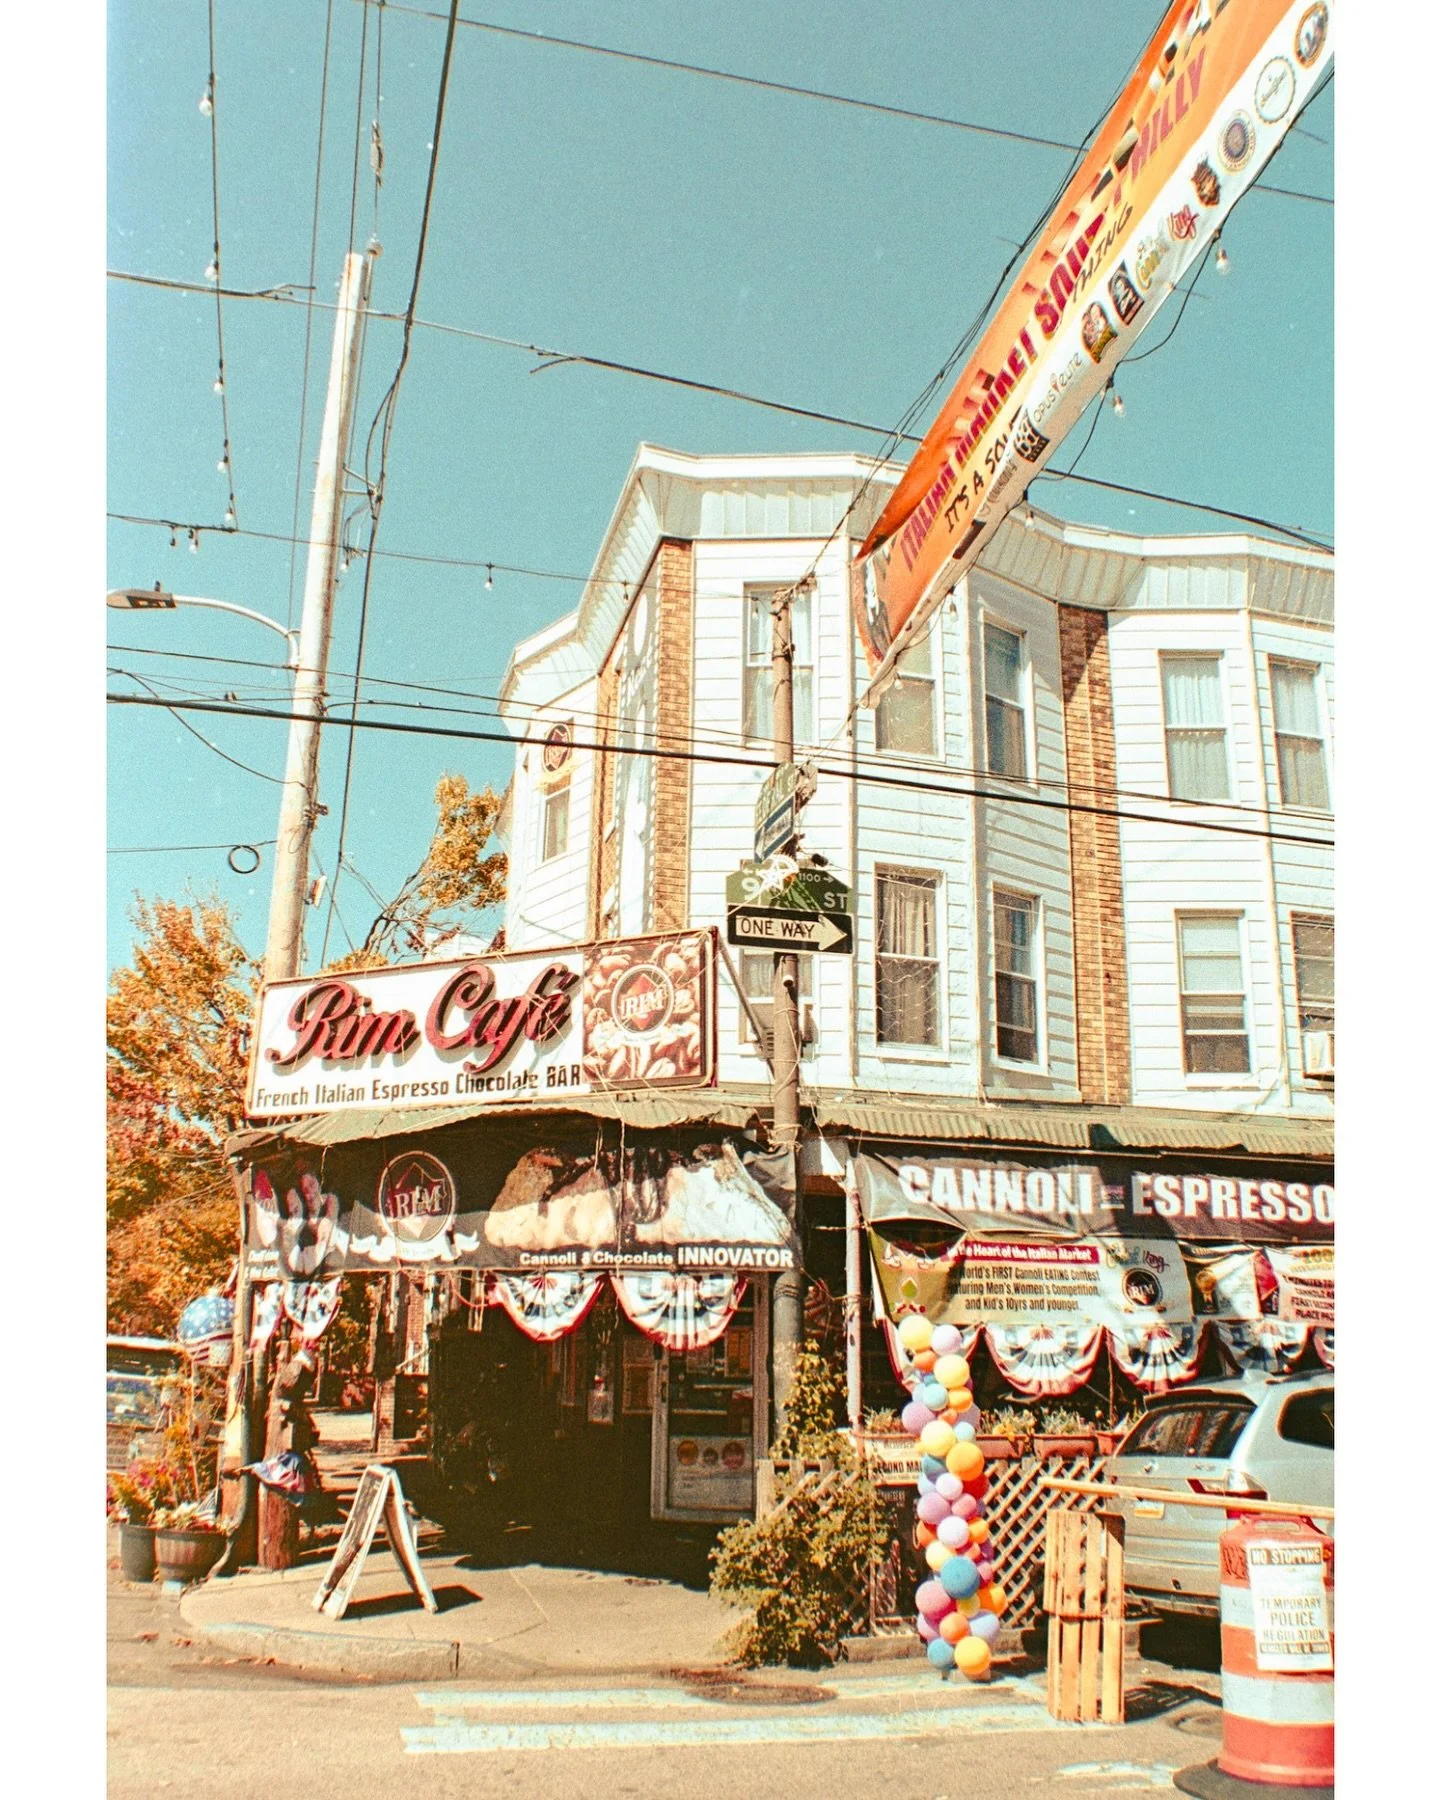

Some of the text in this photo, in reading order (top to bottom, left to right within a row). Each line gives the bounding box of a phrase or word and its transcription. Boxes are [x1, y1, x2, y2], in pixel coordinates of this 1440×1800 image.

[1114, 44, 1206, 206] HILLY
[972, 470, 985, 491] A
[799, 872, 821, 883] 1100
[823, 891, 848, 909] ST
[741, 917, 815, 939] ONE WAY
[265, 980, 421, 1067] Rim
[256, 1064, 581, 1108] French Italian Espresso Chocolate BAR
[899, 1164, 1334, 1223] CANNOLI ESPRESSO
[519, 1251, 576, 1266] Cannoli
[592, 1250, 674, 1265] Chocolate
[678, 1246, 794, 1267] INNOVATOR
[974, 1244, 1000, 1258] Heart
[1028, 1247, 1058, 1260] Italian
[1059, 1248, 1091, 1261] Market
[992, 1266, 1012, 1280] FIRST
[1015, 1267, 1043, 1281] Cannoli
[1044, 1268, 1069, 1281] EATING
[1070, 1269, 1099, 1281] Contest
[965, 1298, 981, 1310] and
[1029, 1299, 1044, 1310] and
[1251, 1548, 1270, 1565] NO
[1261, 1597, 1322, 1609] TEMPORARY
[1271, 1611, 1316, 1627] POLICE
[1262, 1629, 1326, 1641] REGULATION
